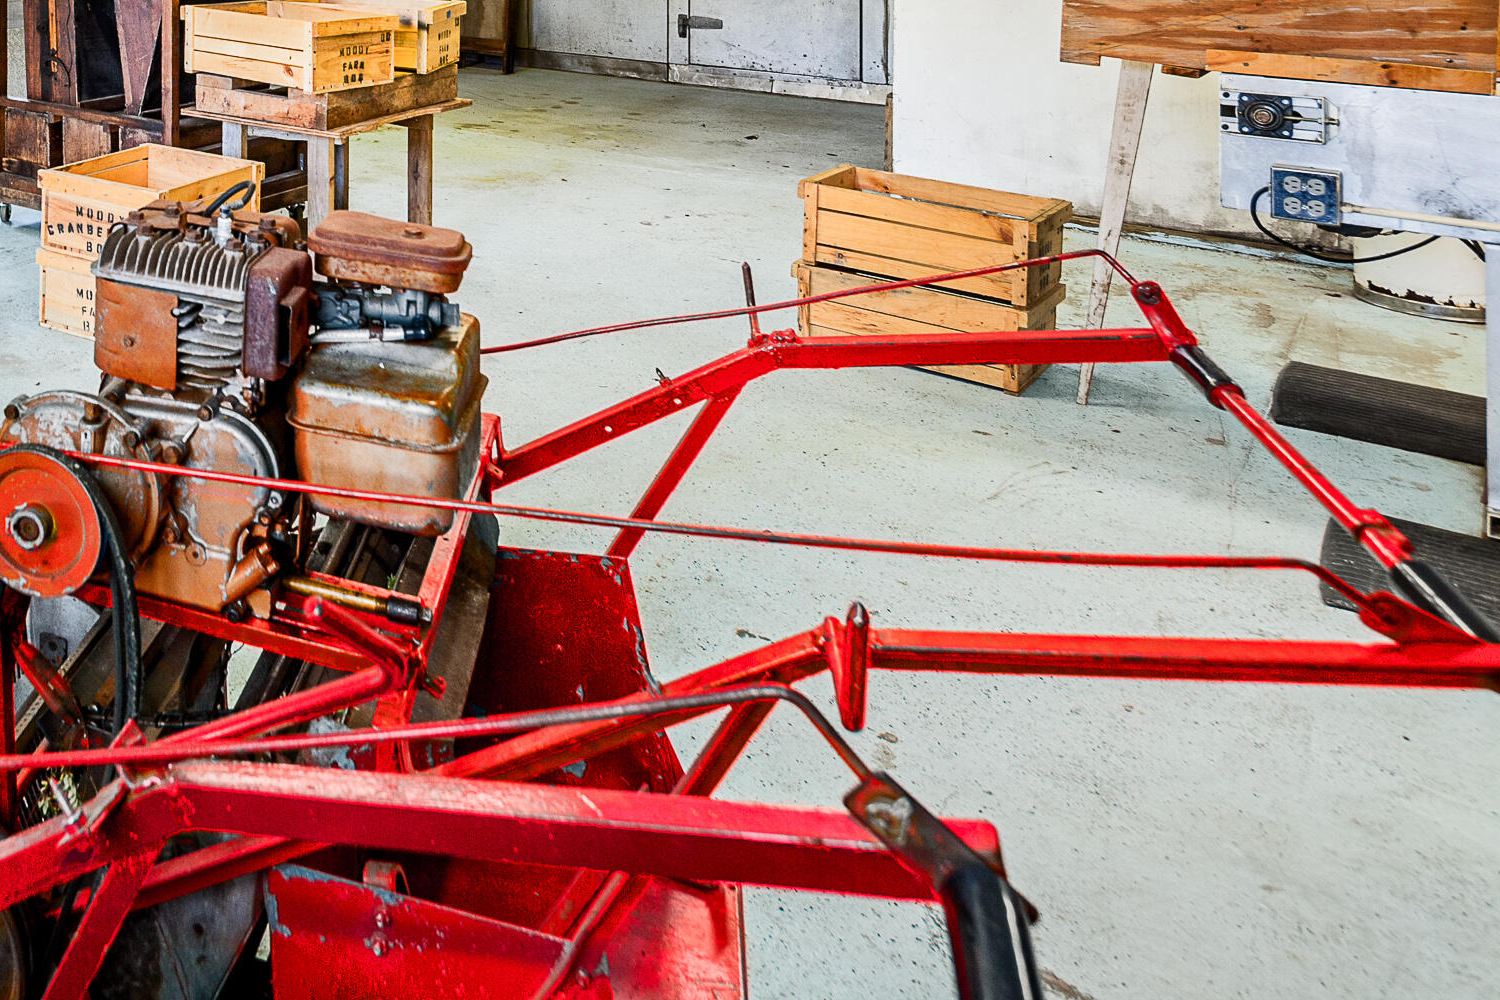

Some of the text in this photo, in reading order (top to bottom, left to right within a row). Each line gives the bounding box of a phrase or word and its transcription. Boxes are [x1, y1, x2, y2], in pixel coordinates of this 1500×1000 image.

[339, 45, 370, 57] MOODY
[342, 60, 365, 72] FARM
[47, 222, 103, 238] CRANBE
[86, 241, 103, 254] BO
